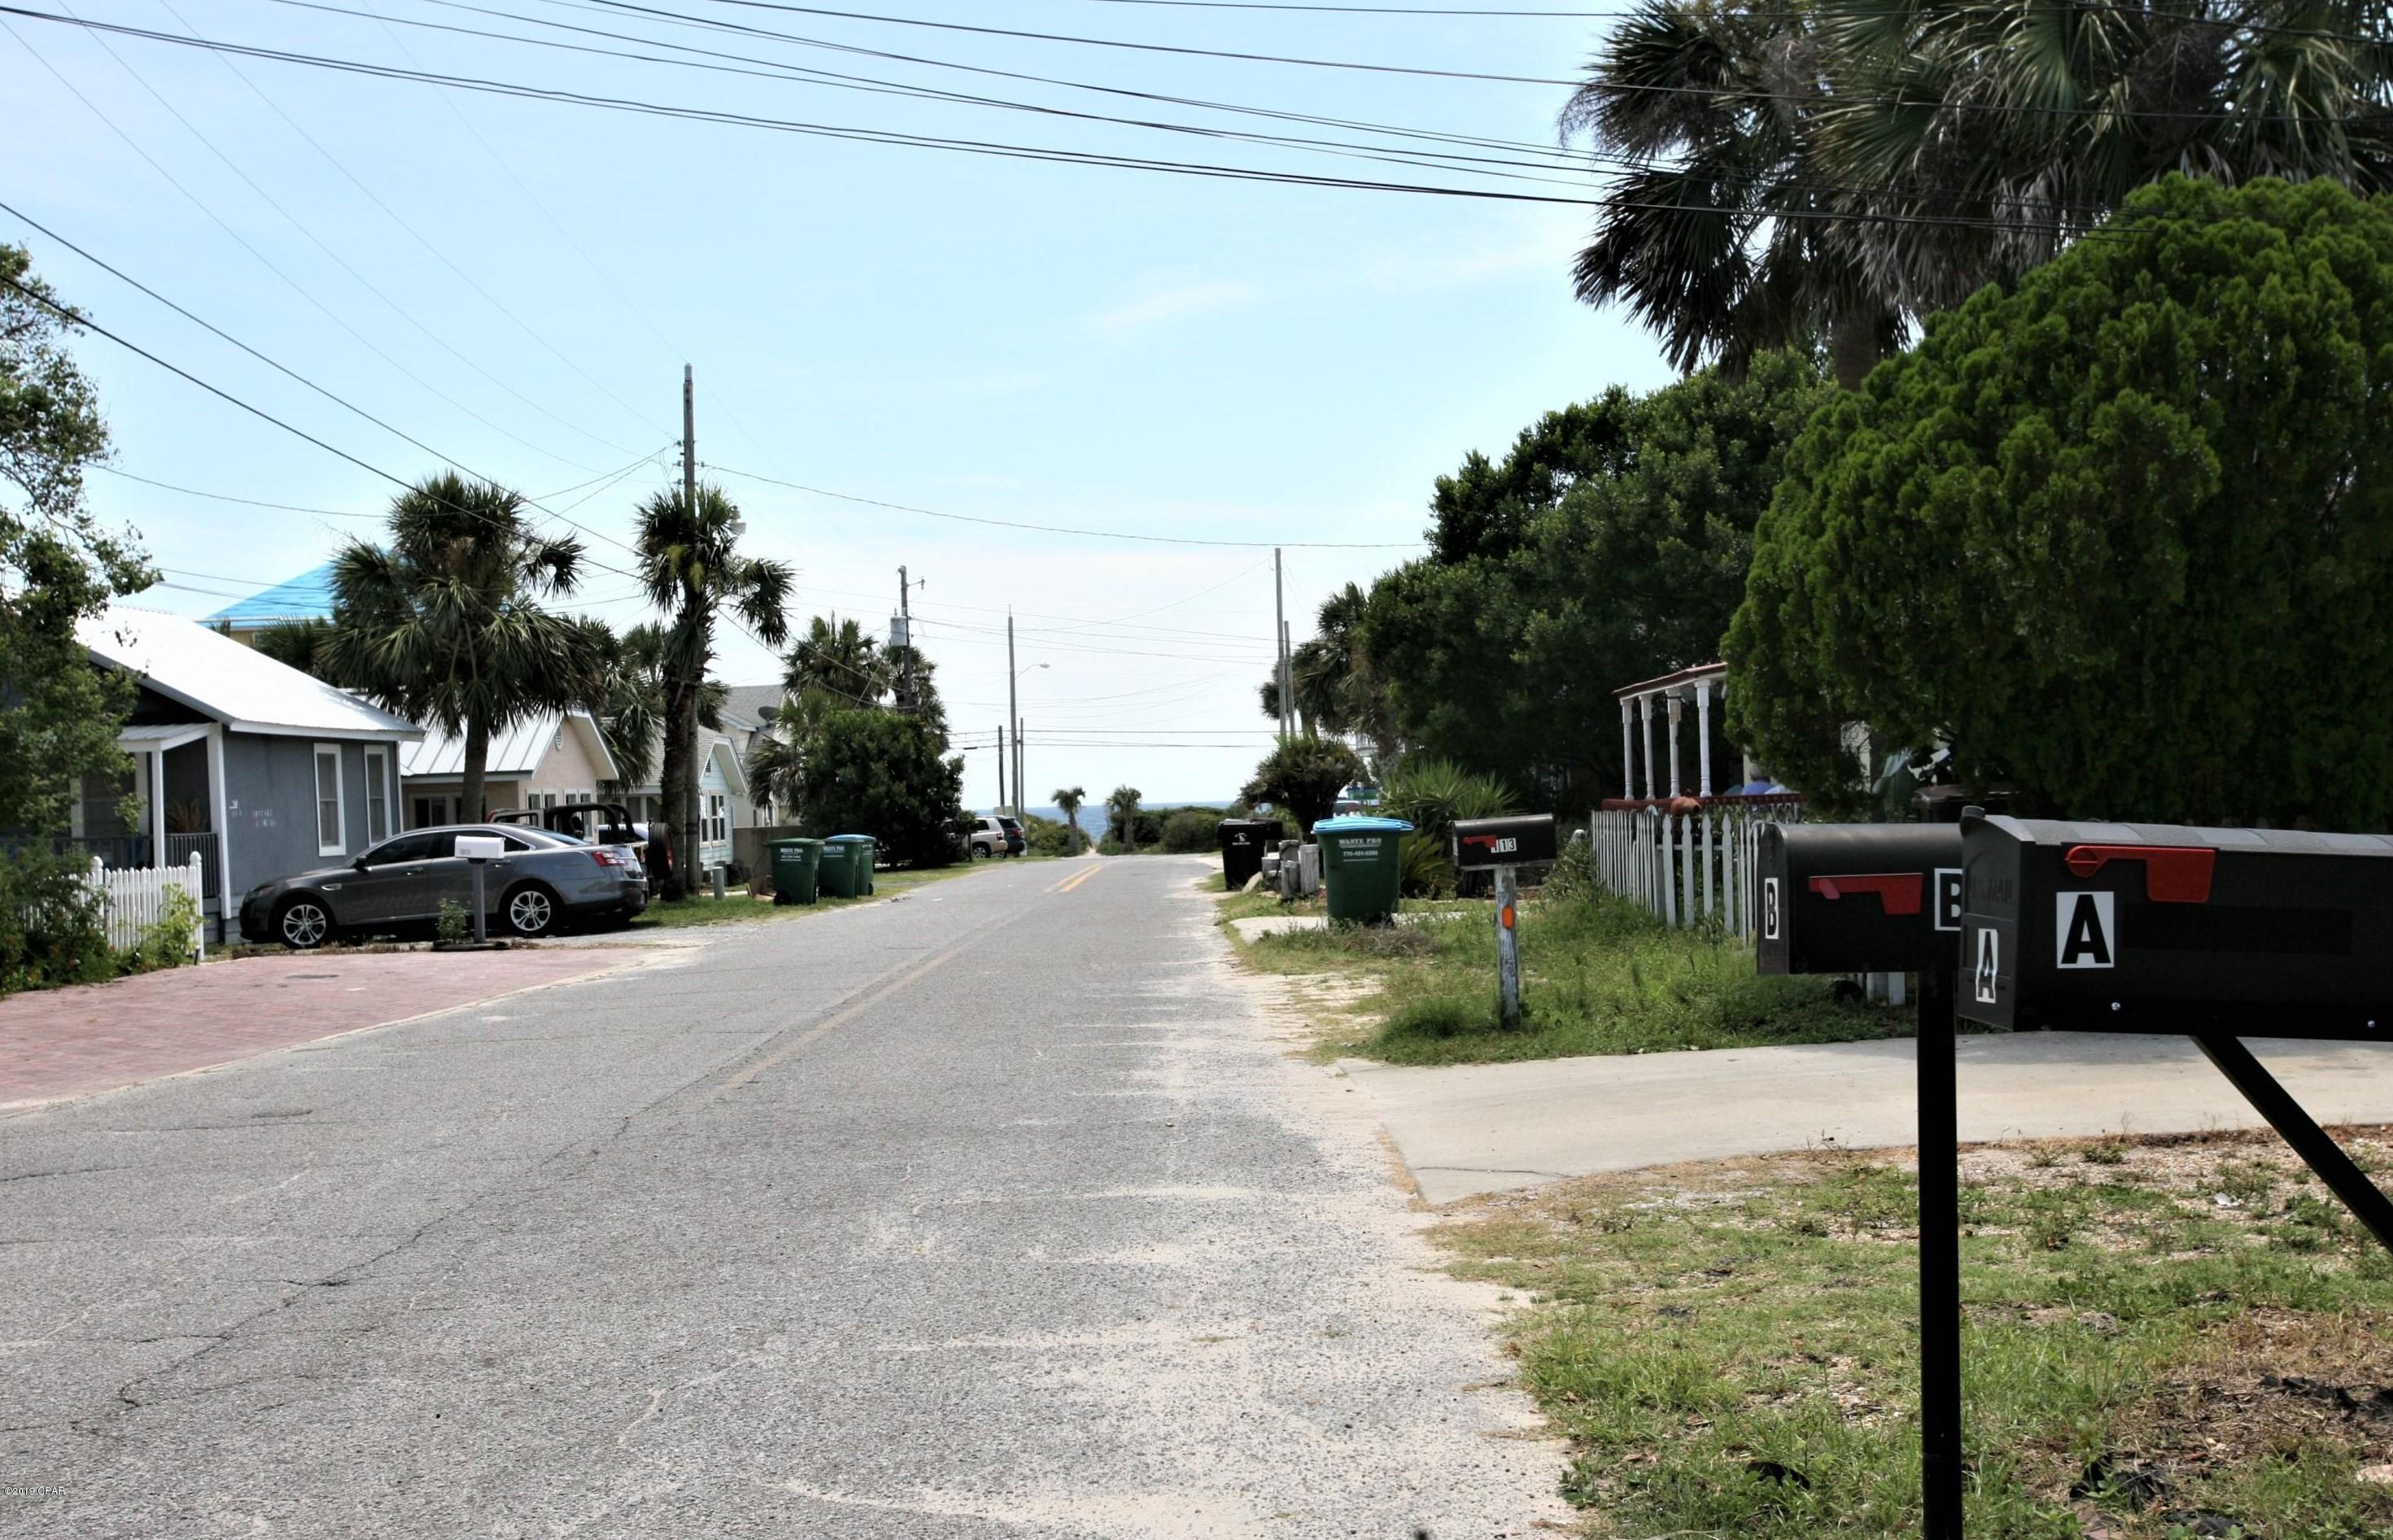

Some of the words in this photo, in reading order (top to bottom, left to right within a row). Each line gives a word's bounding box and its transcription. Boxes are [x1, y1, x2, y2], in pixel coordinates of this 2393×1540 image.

[1766, 883, 1777, 936] B
[1940, 873, 1963, 927] B
[2060, 894, 2111, 965] A
[1977, 931, 1994, 999] A
